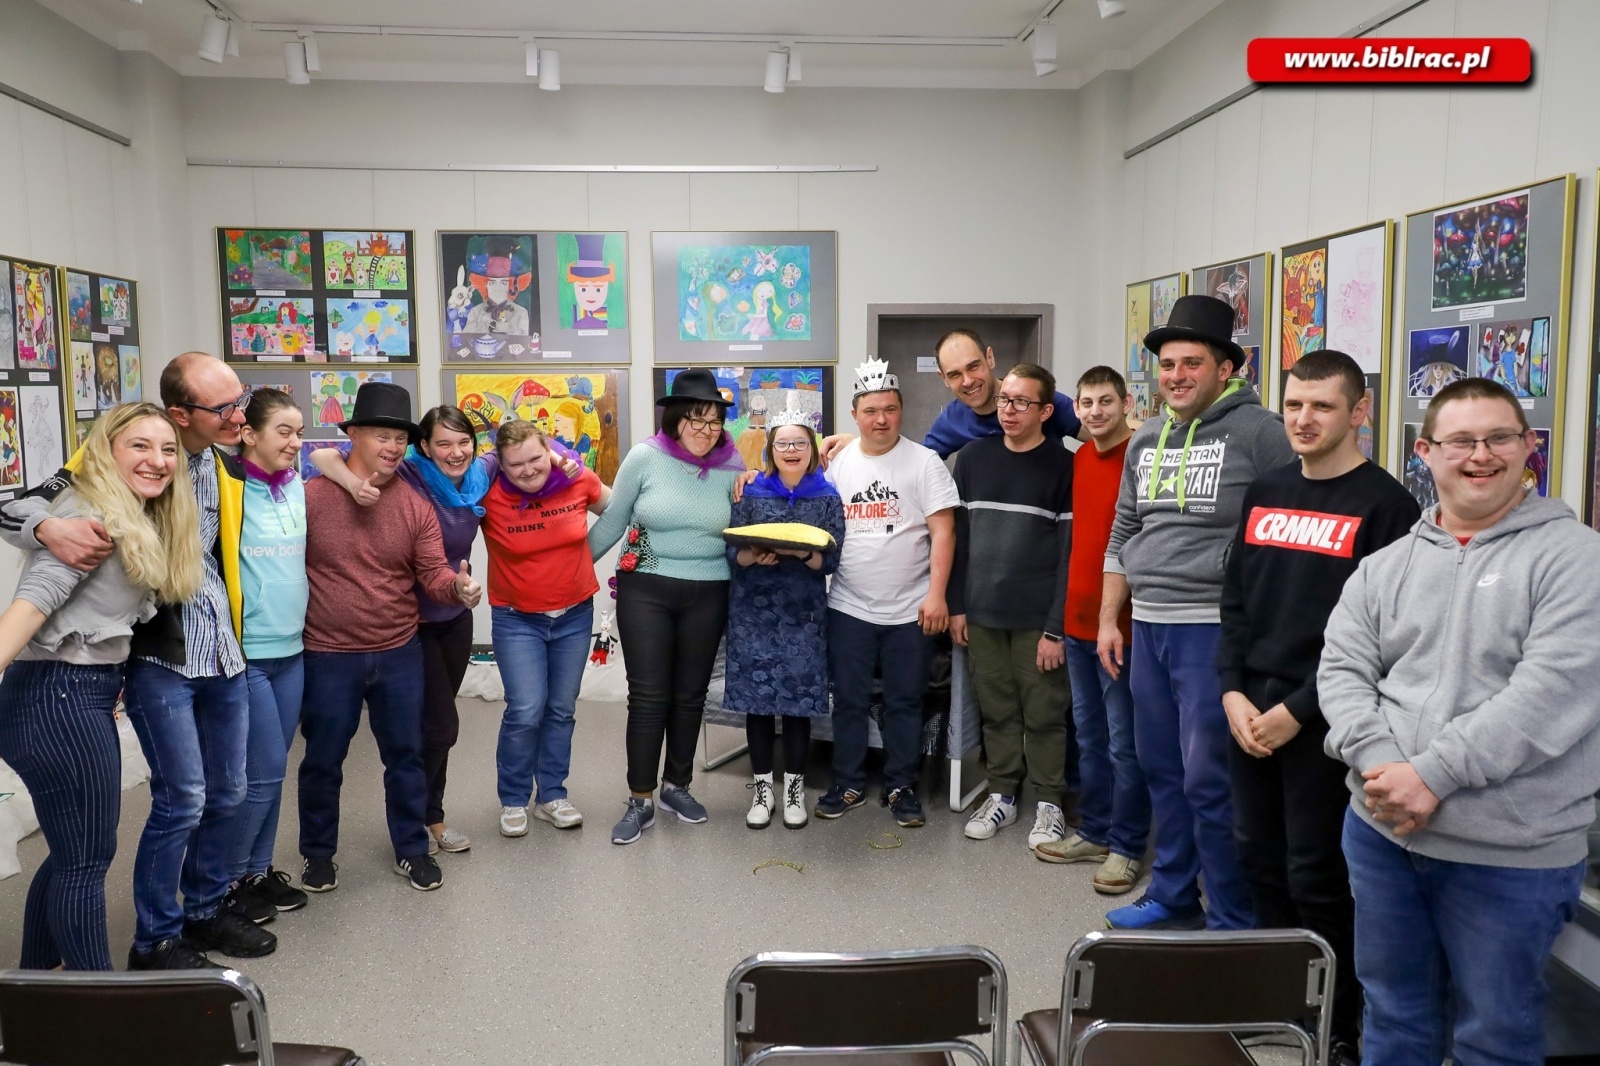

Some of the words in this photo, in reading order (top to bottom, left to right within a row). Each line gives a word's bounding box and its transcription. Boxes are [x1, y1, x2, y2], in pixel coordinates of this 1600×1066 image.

[511, 501, 543, 511] WRK
[541, 503, 579, 518] MONEY
[507, 522, 545, 534] DRINK
[1254, 512, 1352, 551] CRMNL!
[243, 545, 276, 557] new
